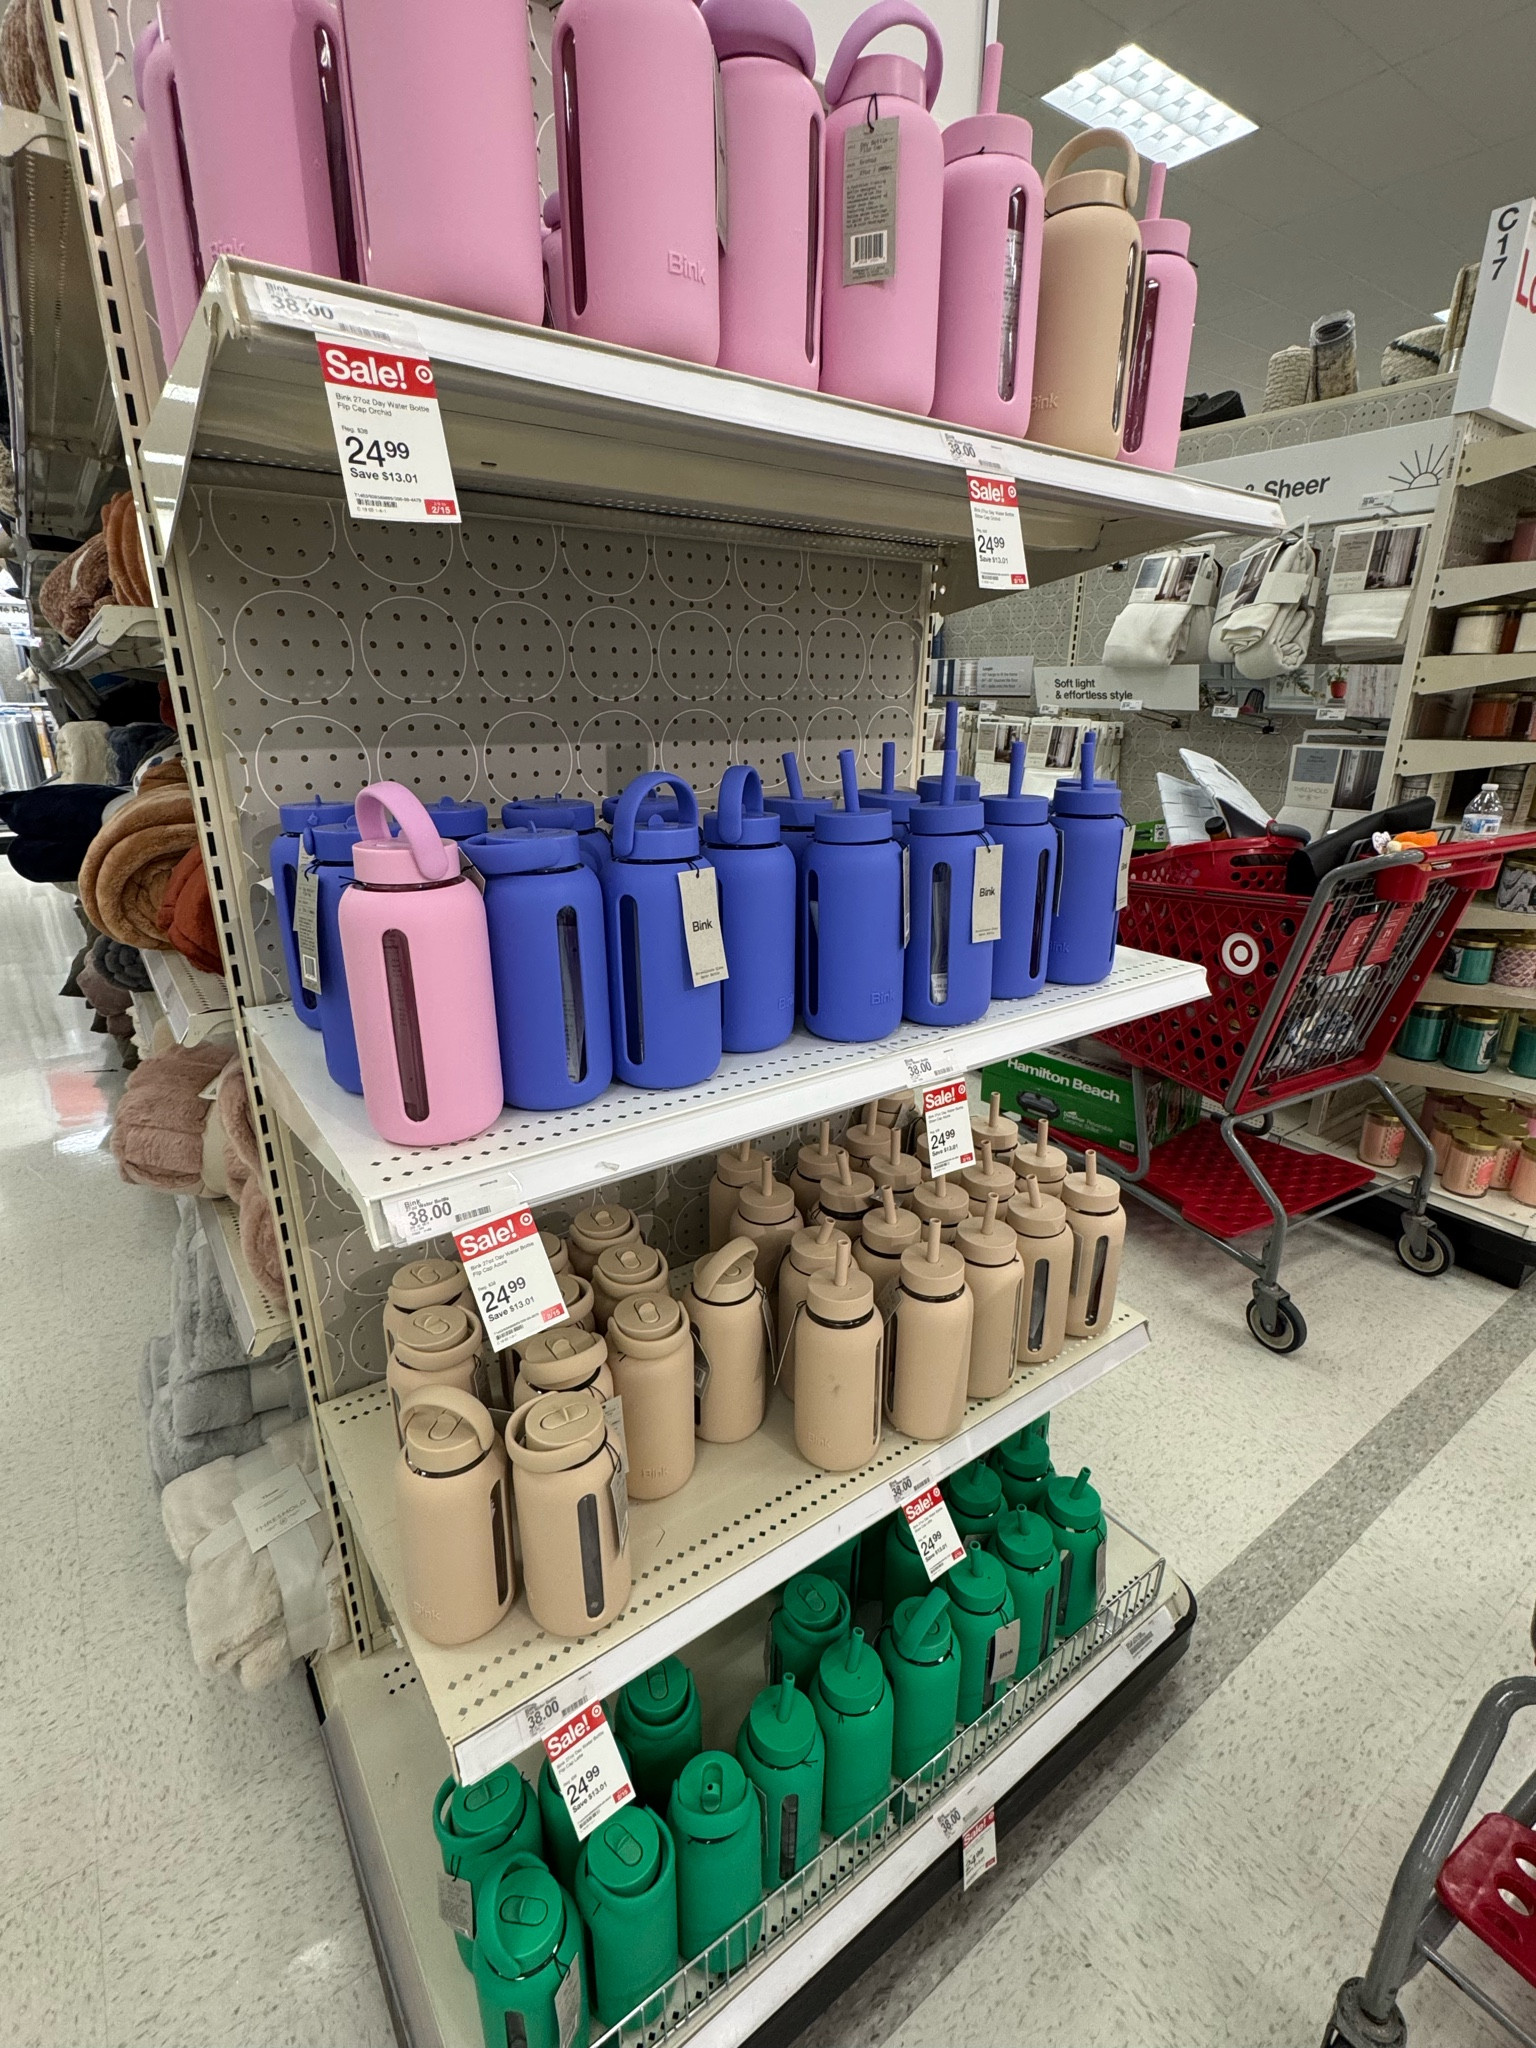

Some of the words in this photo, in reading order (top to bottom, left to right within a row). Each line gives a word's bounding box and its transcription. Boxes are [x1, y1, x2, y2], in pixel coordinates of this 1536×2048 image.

[667, 250, 706, 285] Bink
[270, 294, 334, 320] 38.00
[325, 349, 407, 390] Sale!
[335, 392, 352, 401] Bink
[372, 398, 386, 408] Day
[387, 401, 408, 410] Water
[409, 403, 430, 413] Bottle
[337, 402, 351, 411] Flip
[352, 404, 367, 414] Cap
[368, 407, 392, 416] Orchid
[350, 467, 379, 480] Save
[383, 471, 418, 484] $13.01
[1264, 476, 1331, 498] Sheer
[970, 479, 1005, 503] Sale!
[431, 506, 451, 514] 2/15
[1054, 678, 1073, 688] Soft
[1075, 678, 1095, 689] light
[1055, 690, 1062, 700] &
[1063, 690, 1108, 700] effortless
[1110, 690, 1133, 702] style
[979, 886, 996, 897] Bink
[692, 918, 713, 932] Bink
[907, 1061, 932, 1077] 38.00
[1007, 1058, 1070, 1087] Hamilton
[1072, 1078, 1120, 1104] Beach
[925, 1087, 956, 1109] Sale!
[404, 1198, 420, 1208] Bink
[408, 1201, 452, 1226] 38.00
[460, 1218, 517, 1257] Sale!
[488, 1309, 508, 1322] Save
[509, 1296, 535, 1313] $13.01
[906, 1493, 934, 1520] Sale!
[527, 1700, 559, 1729] 38.00
[548, 1713, 591, 1757] Sale!
[572, 1798, 588, 1813] Save
[588, 1781, 608, 1800] $13.01
[964, 1818, 987, 1847] Sale!
